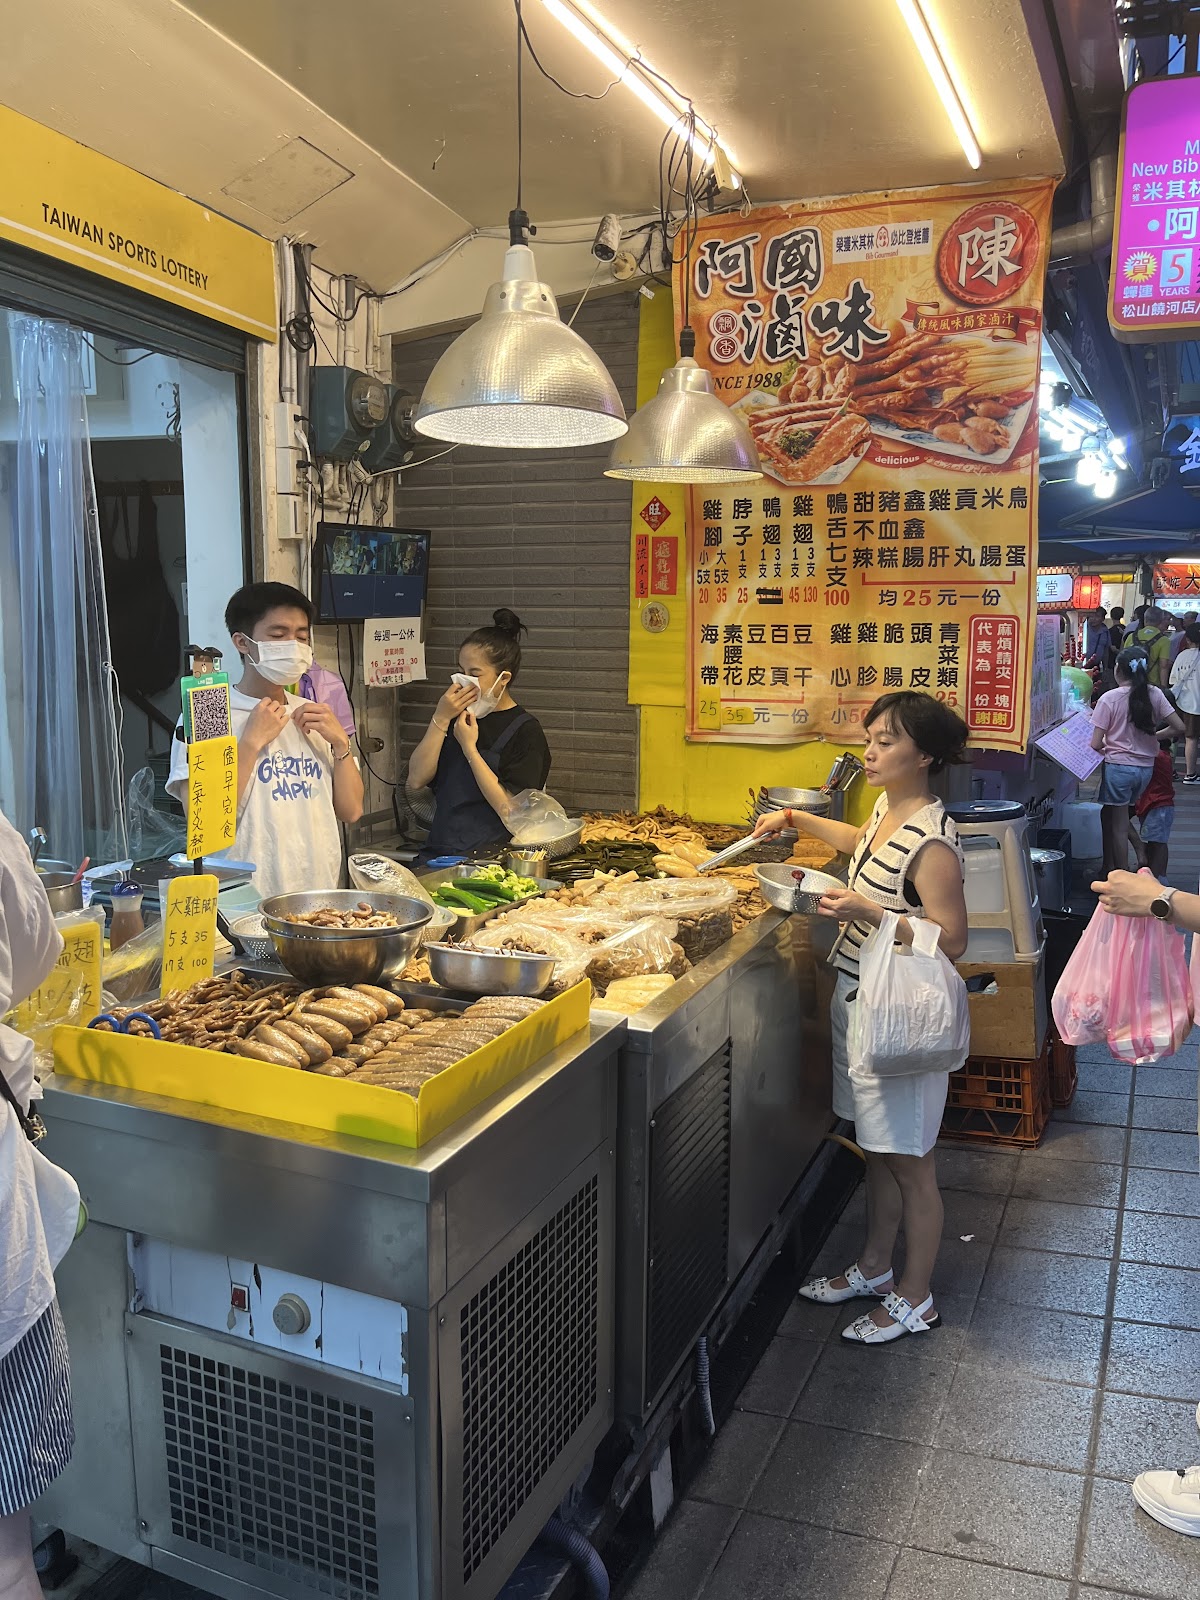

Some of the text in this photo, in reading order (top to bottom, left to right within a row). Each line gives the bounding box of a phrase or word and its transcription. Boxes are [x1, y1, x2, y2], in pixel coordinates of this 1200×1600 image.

[1132, 158, 1198, 177] New Bib
[41, 202, 209, 291] TAIWAN SPORTS LOTTERY
[866, 249, 898, 260] Bib Gourmand
[958, 216, 1023, 287] 陳
[697, 226, 823, 296] 阿國
[1129, 257, 1151, 278] 賀
[1166, 253, 1186, 283] 5
[1159, 286, 1190, 296] YEARS
[743, 281, 889, 361] 滷味
[917, 313, 1014, 331] 傳統風味獨家滷汁
[747, 372, 783, 389] 1988
[874, 455, 920, 465] delicious
[649, 502, 661, 516] 旺
[699, 588, 709, 603] 20
[716, 587, 727, 603] 35
[737, 587, 748, 603] 25
[789, 587, 800, 603] 45
[803, 586, 818, 603] 130
[823, 589, 850, 606] 100
[374, 628, 415, 642] 每週一公休
[975, 622, 993, 707] 代表為一份
[976, 711, 1007, 726] 謝謝
